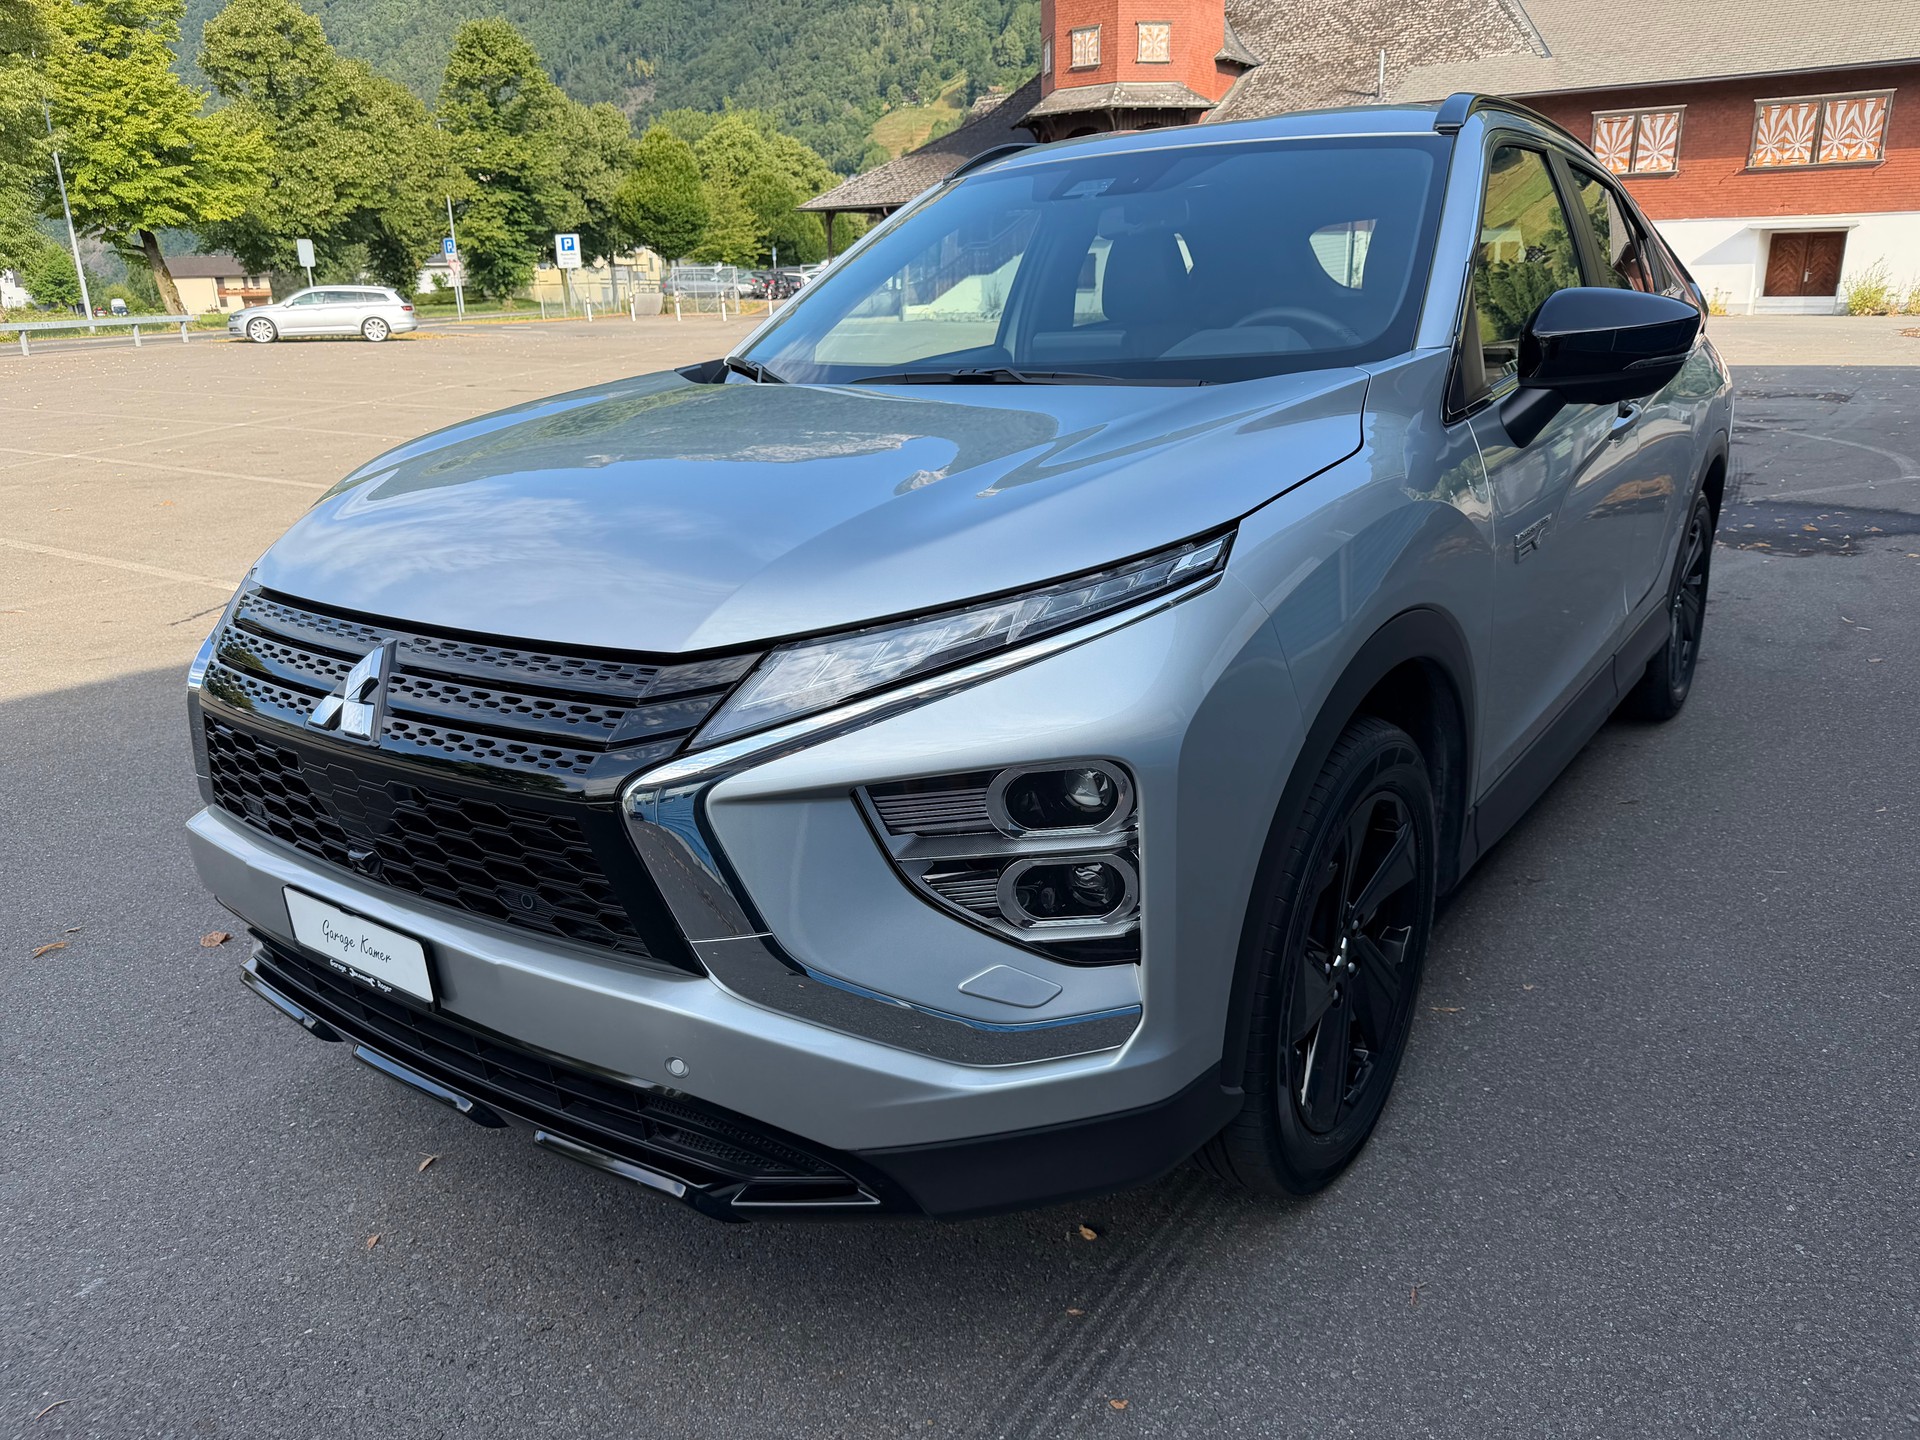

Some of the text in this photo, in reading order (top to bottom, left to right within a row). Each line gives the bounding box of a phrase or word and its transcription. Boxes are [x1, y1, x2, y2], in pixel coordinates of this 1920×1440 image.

[563, 238, 572, 251] P
[322, 919, 391, 963] Garage Kamer
